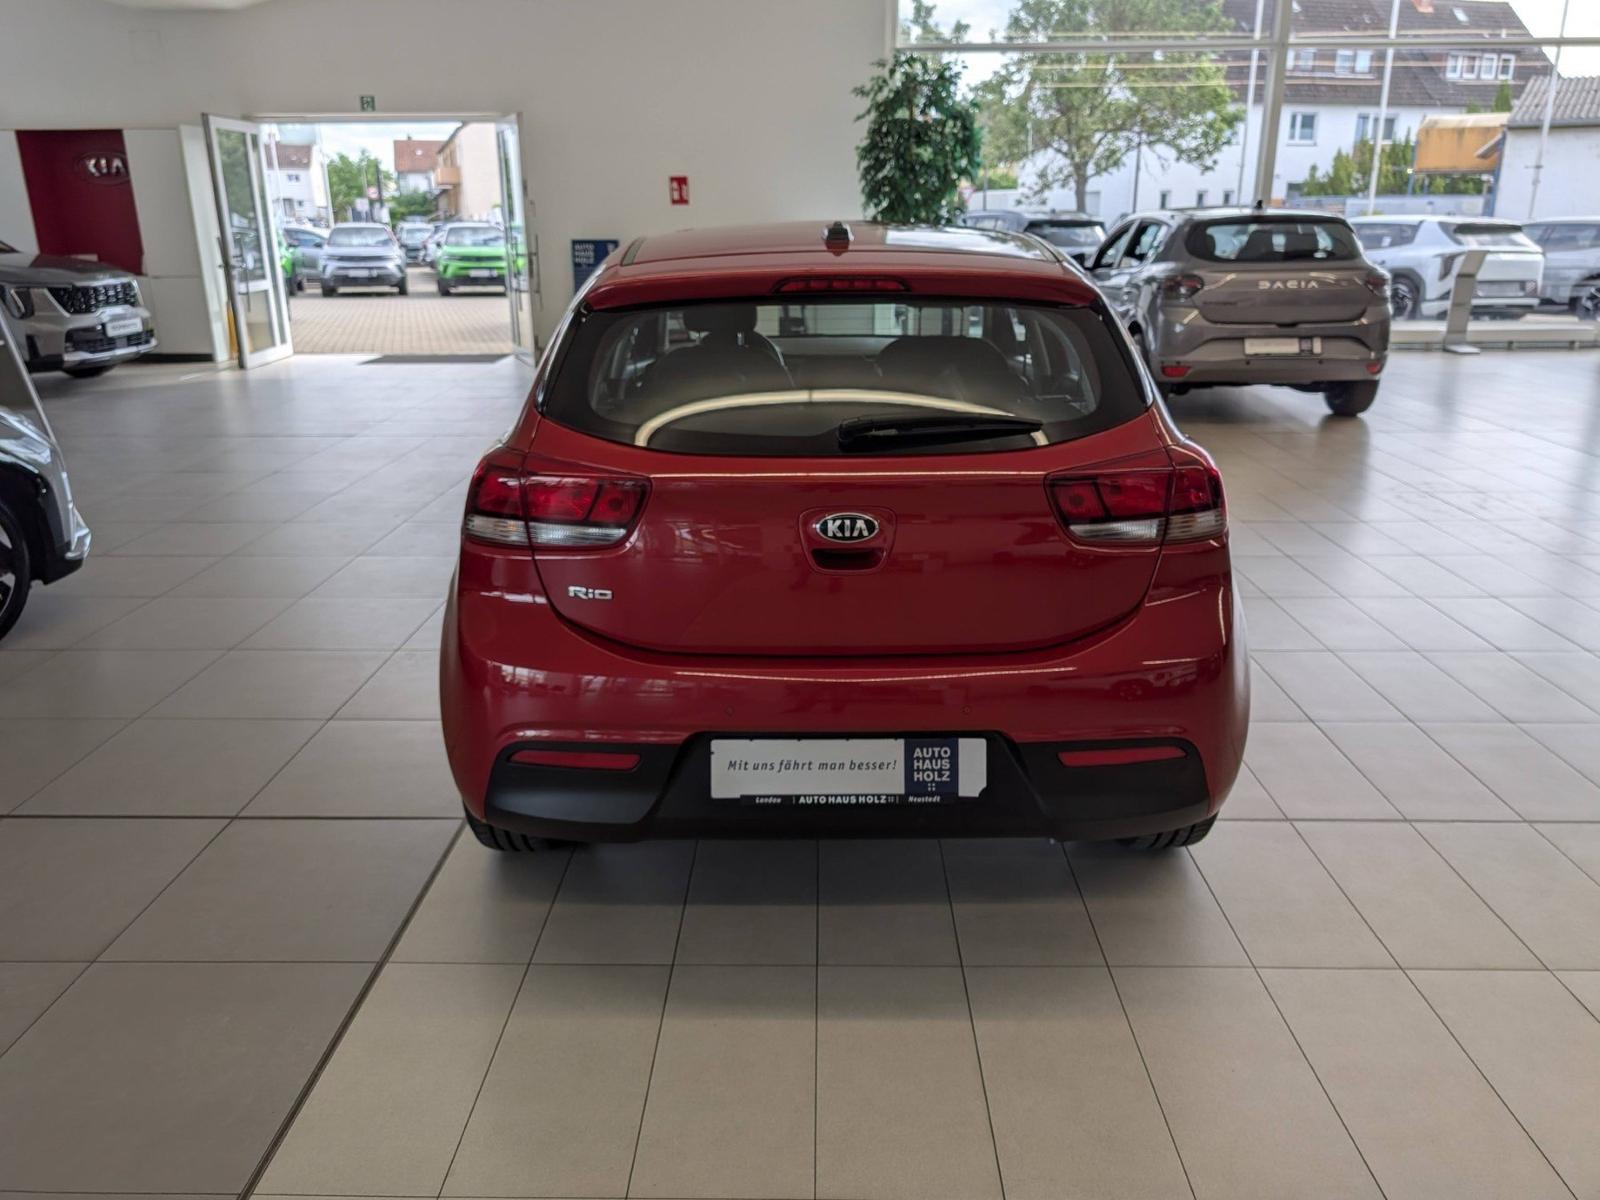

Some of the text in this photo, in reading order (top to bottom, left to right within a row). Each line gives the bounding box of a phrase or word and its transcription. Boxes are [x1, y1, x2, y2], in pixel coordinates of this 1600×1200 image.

[86, 157, 127, 177] KIA
[1257, 280, 1319, 289] DACIA
[827, 519, 869, 537] KIA
[568, 586, 612, 600] Rio
[913, 747, 951, 758] AUTO
[727, 759, 897, 774] Mit uns fährt man besser!
[913, 759, 951, 770] HAUS
[913, 771, 951, 782] HOLZ
[858, 795, 887, 804] HOLZ
